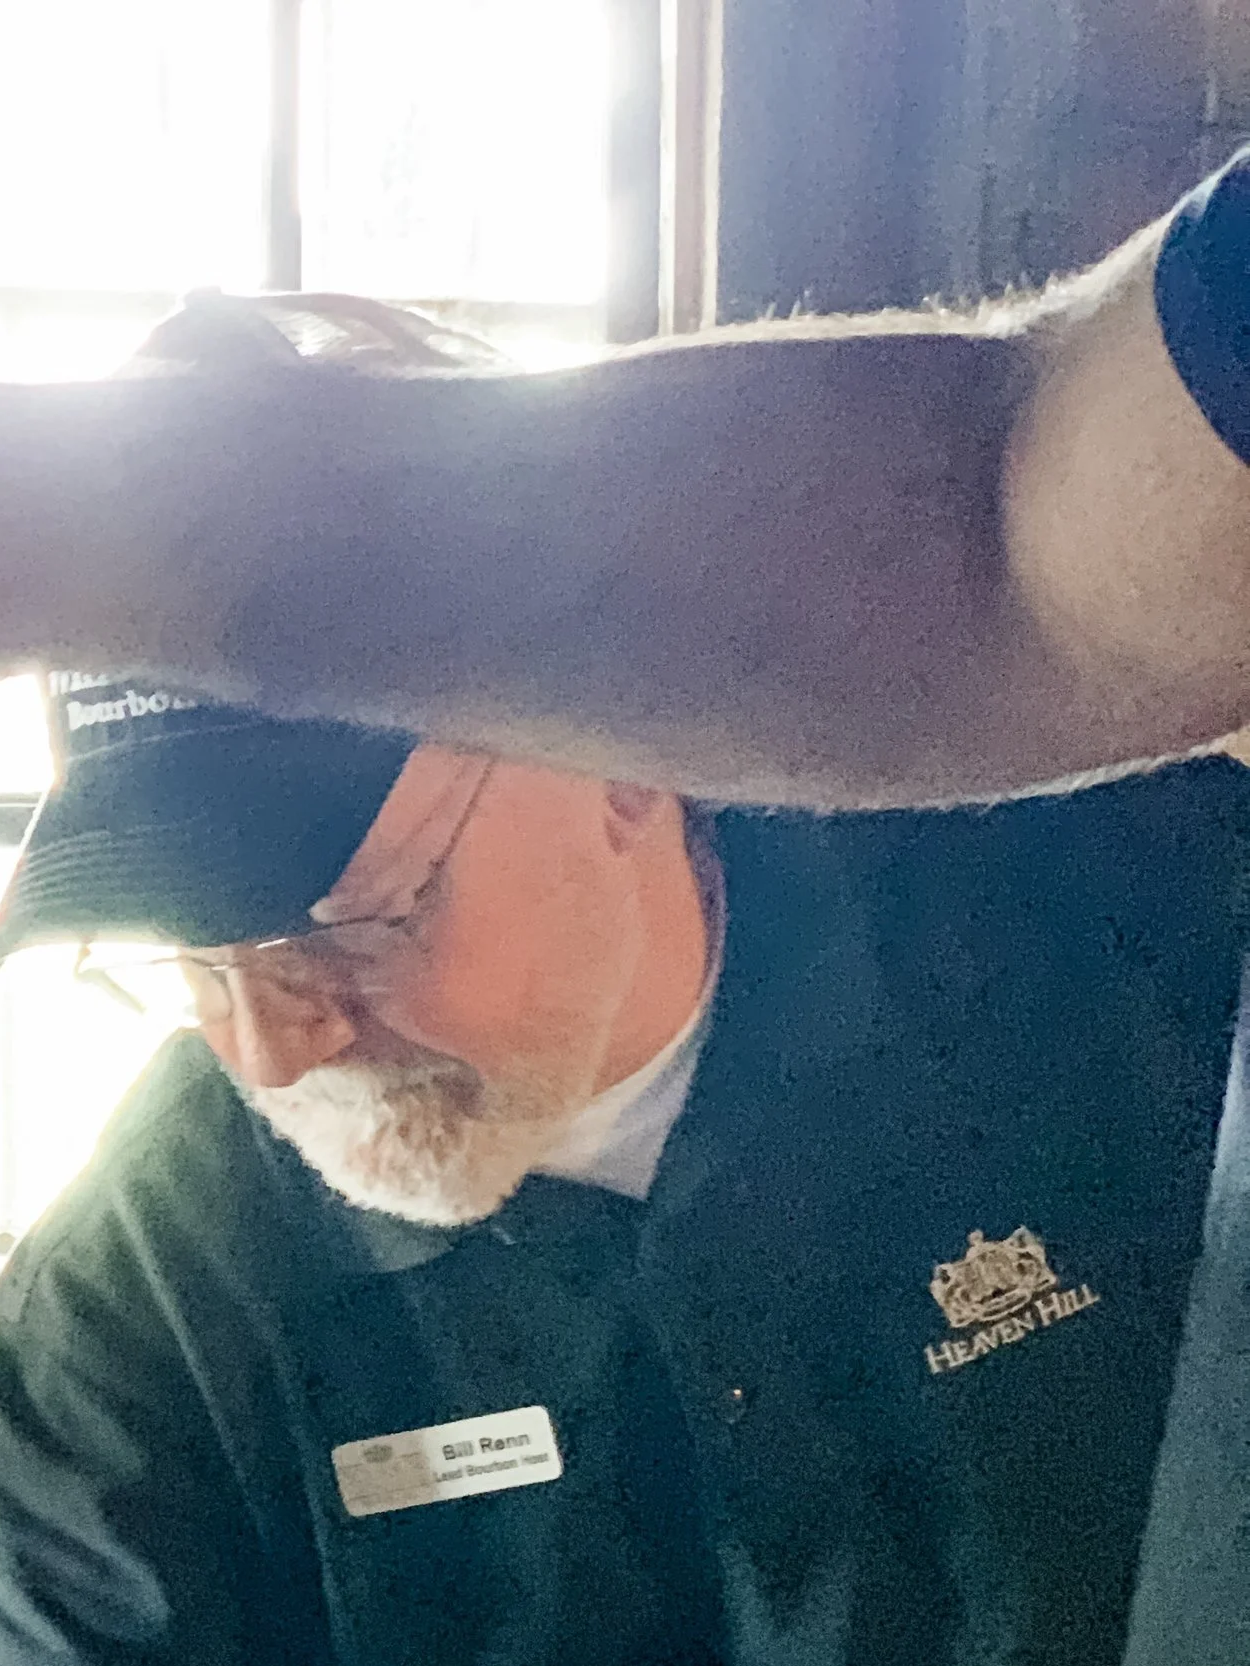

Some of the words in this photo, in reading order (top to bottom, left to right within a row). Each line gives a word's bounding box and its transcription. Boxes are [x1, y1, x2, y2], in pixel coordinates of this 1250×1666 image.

[924, 1311, 1036, 1374] HEAVEN
[1034, 1284, 1100, 1326] HILL
[442, 1440, 474, 1461] Bill
[479, 1434, 531, 1454] Renn
